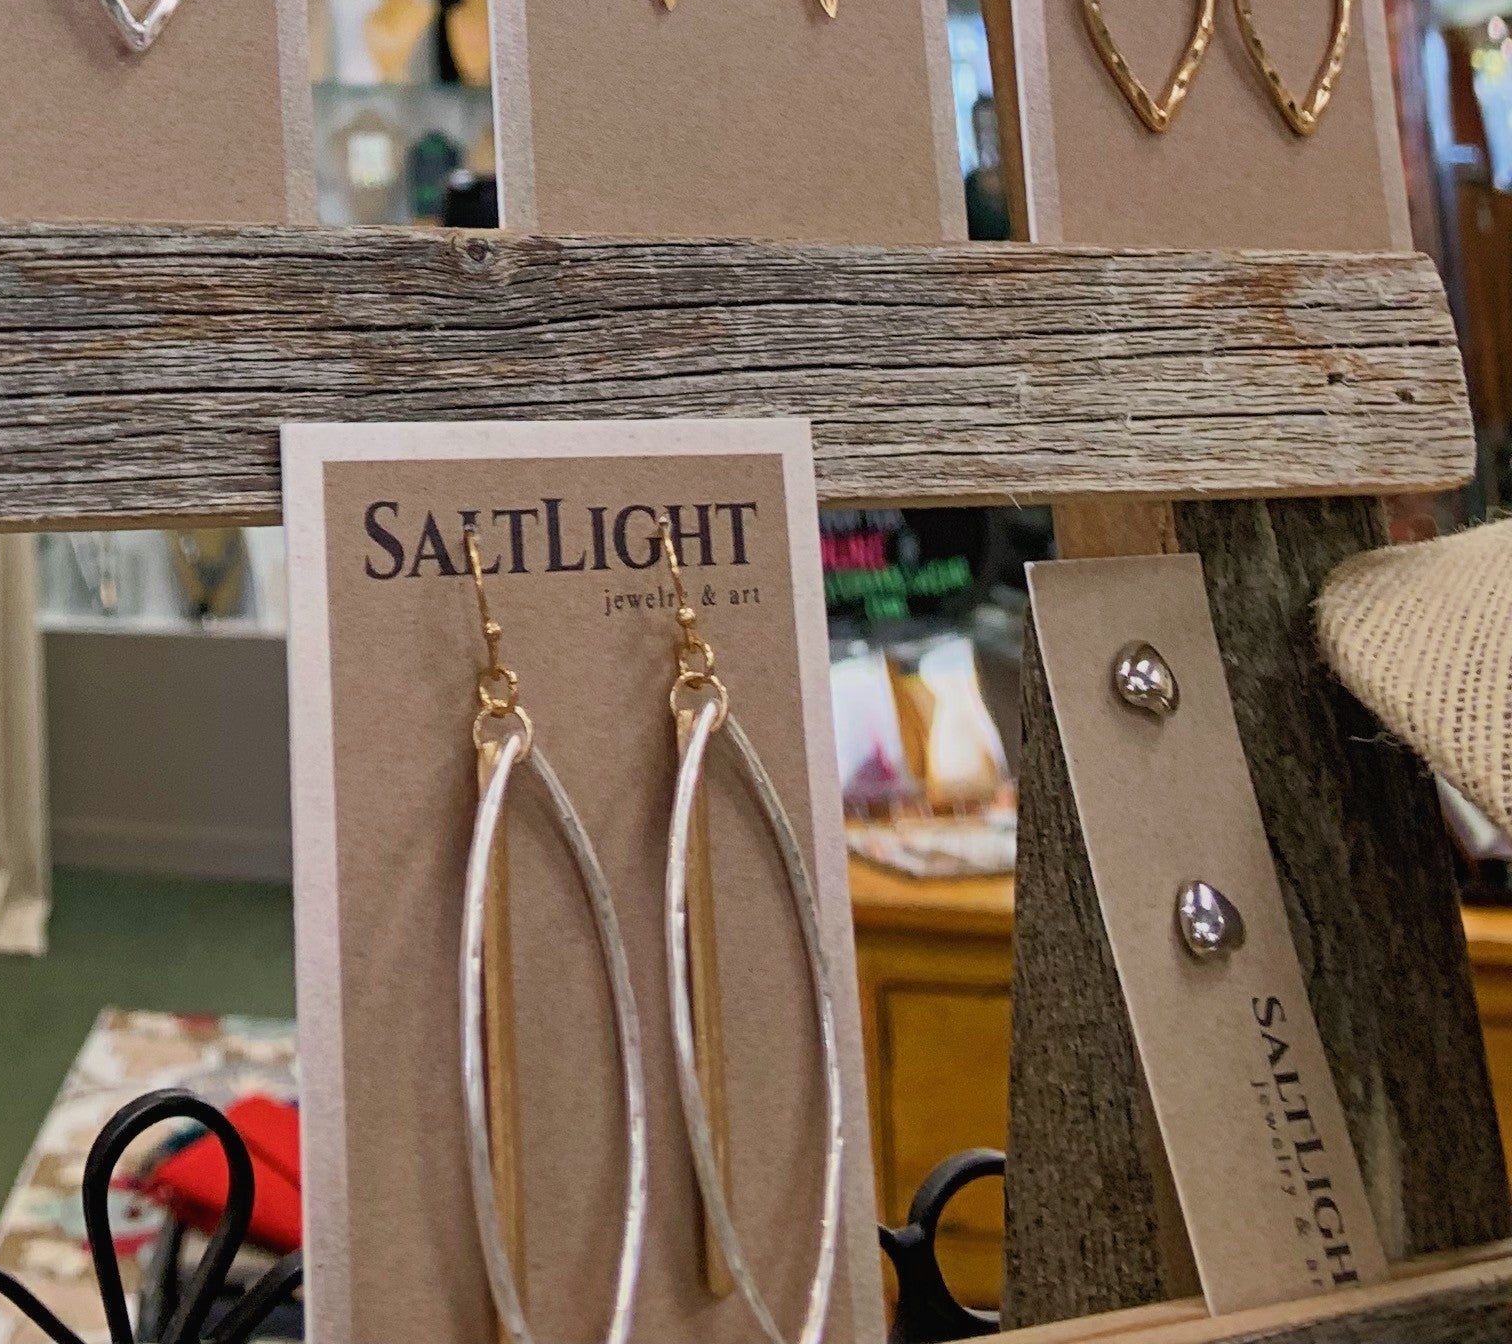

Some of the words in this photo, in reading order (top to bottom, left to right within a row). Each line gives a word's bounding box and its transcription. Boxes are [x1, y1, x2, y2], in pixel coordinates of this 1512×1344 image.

[701, 583, 718, 607] &
[729, 586, 761, 605] art
[1251, 994, 1360, 1286] SALTLIGH
